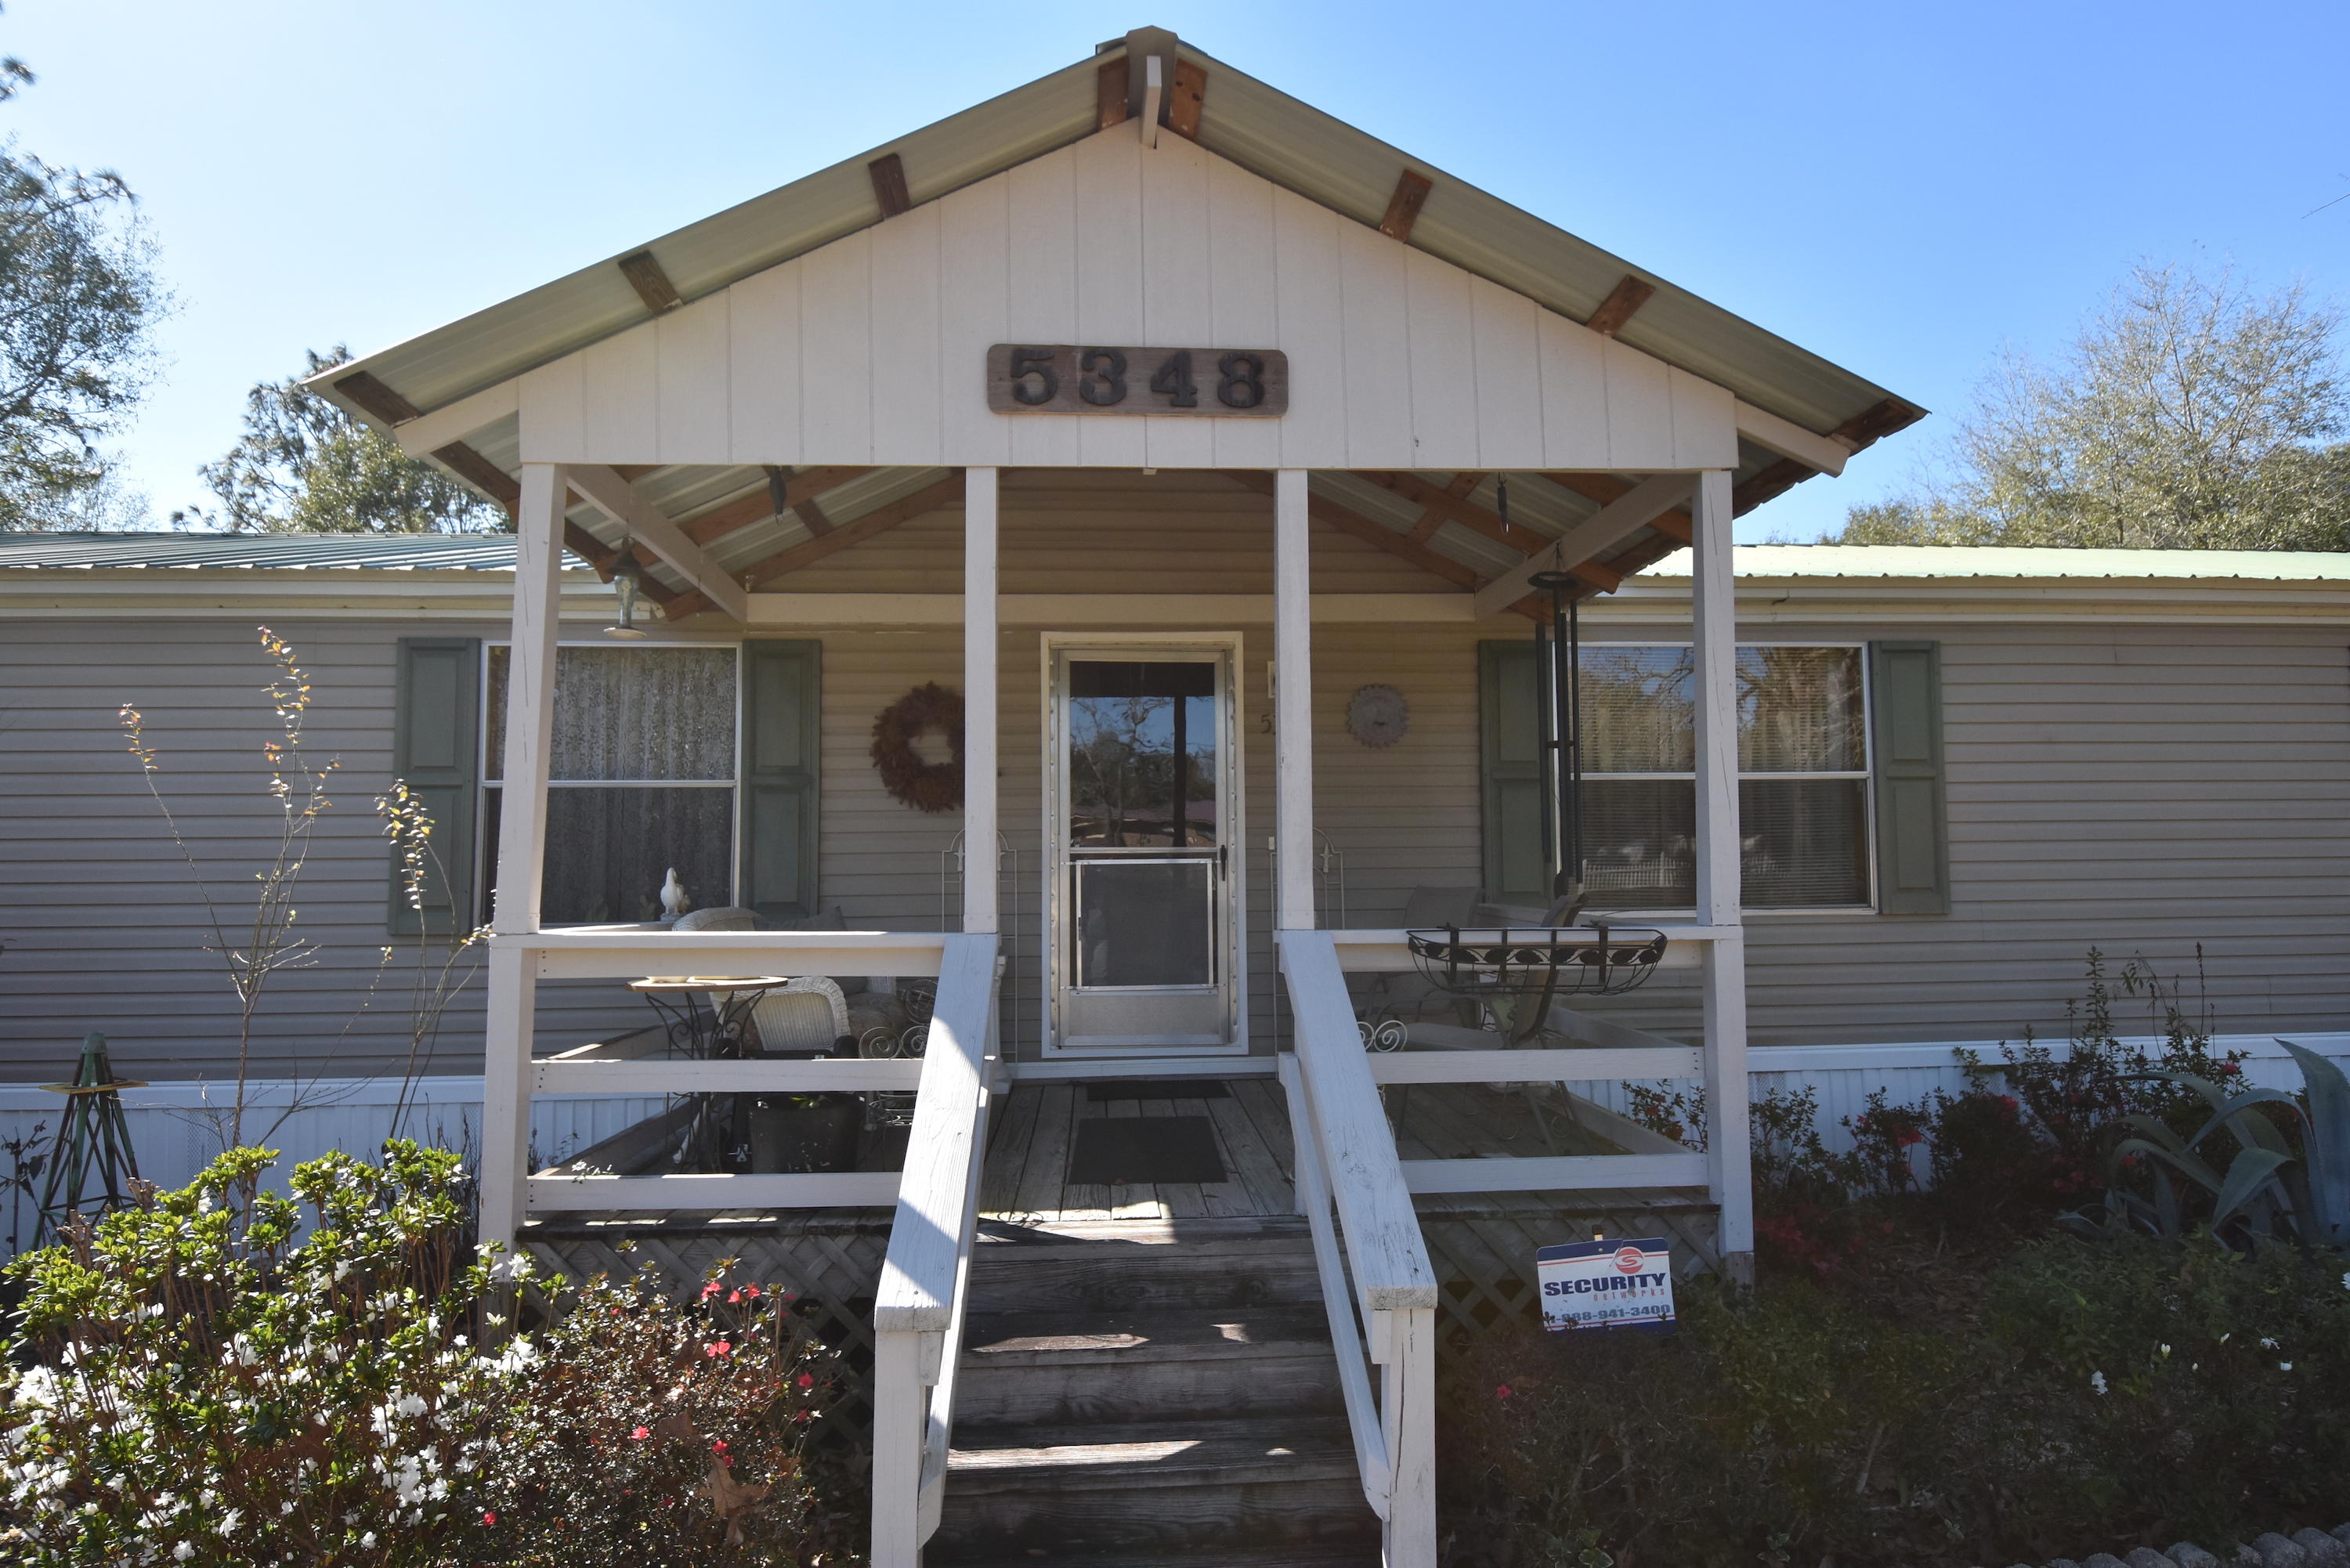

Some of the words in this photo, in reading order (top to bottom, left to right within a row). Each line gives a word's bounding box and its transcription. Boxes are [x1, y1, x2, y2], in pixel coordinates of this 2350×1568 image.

[1010, 347, 1266, 408] 5348
[1544, 1273, 1667, 1296] SECURITY
[1593, 1288, 1665, 1301] networks
